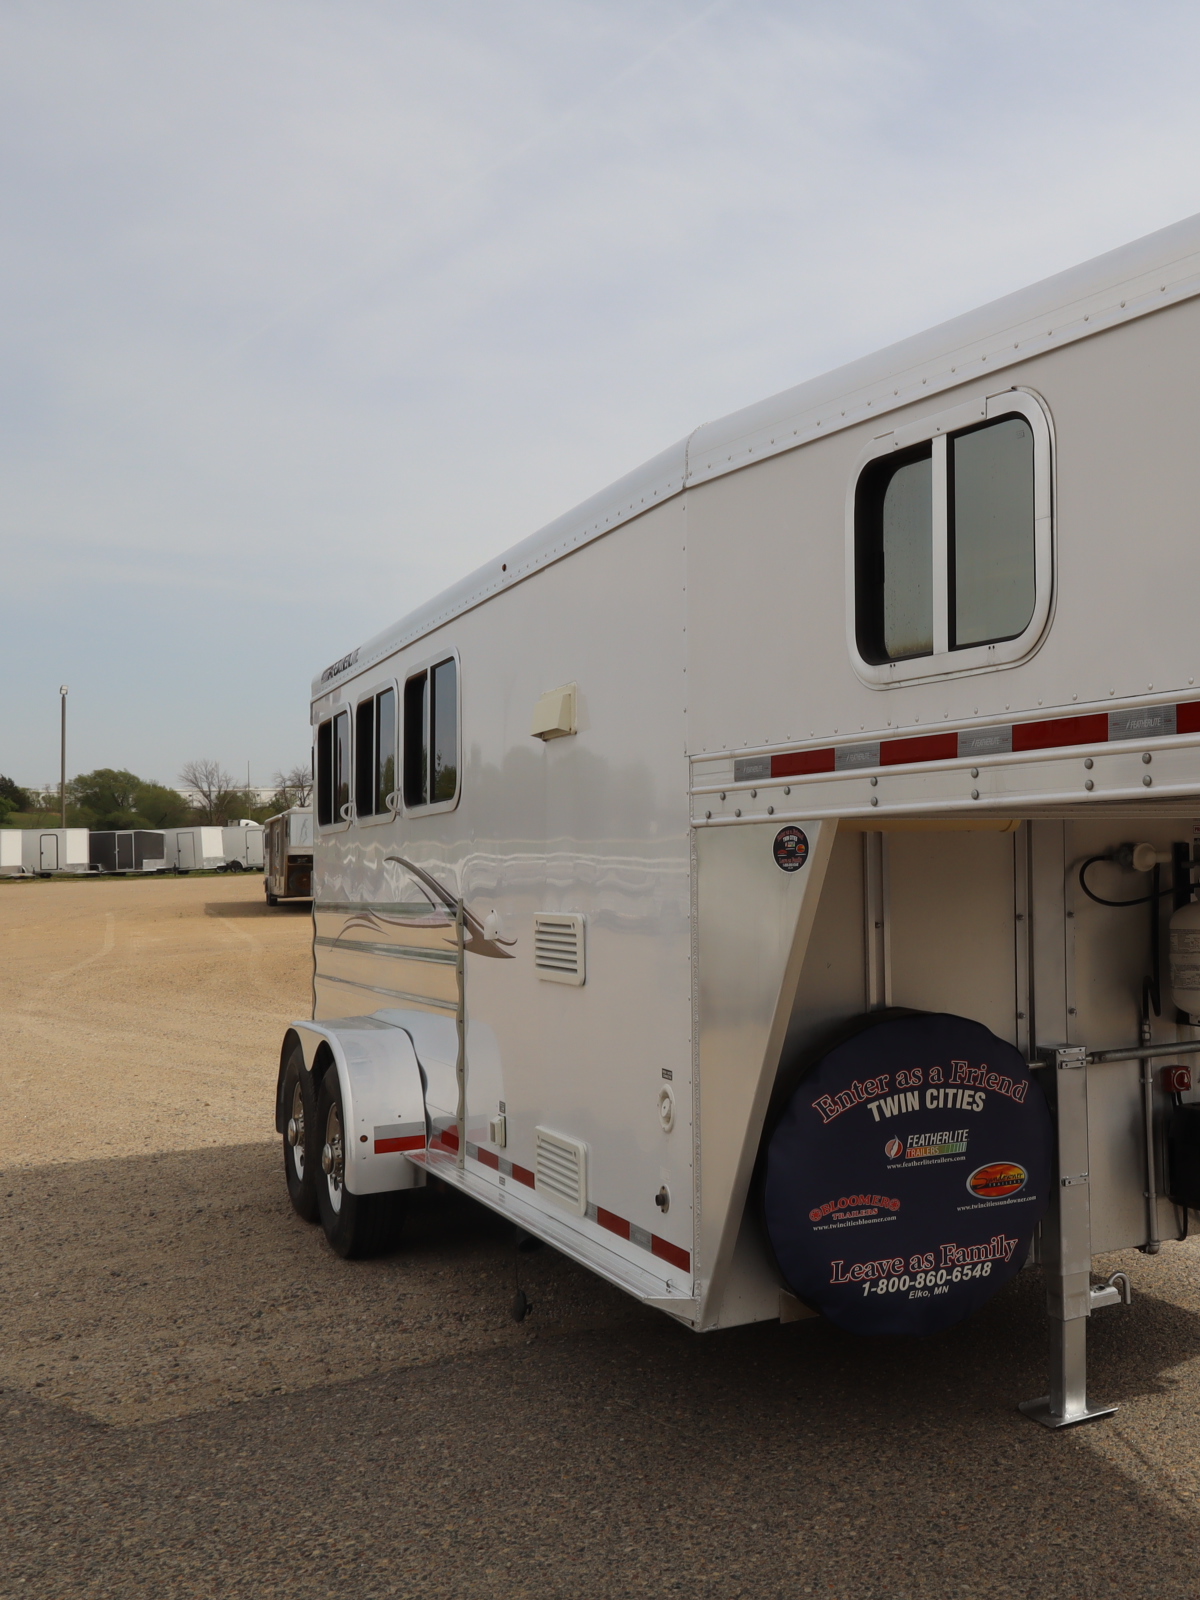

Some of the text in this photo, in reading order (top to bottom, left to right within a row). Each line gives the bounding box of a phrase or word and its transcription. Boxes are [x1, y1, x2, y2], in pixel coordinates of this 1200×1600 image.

[812, 1060, 1029, 1123] Enter as a Friend
[867, 1088, 986, 1122] TWIN CITIES
[907, 1129, 969, 1148] FEATHERLITE
[906, 1147, 939, 1158] TRAILERS
[887, 1156, 966, 1169] www.featherlitetrailers.com
[973, 1170, 1023, 1188] Sundowner
[820, 1194, 891, 1216] BLOOMER
[957, 1195, 1037, 1211] www.twincitiessundowner.com
[813, 1215, 897, 1231] www.twincitiesbloomer.com
[832, 1208, 879, 1221] TRAILERS
[829, 1234, 1019, 1284] Leave as Family
[862, 1261, 992, 1297] 1-800-860-6548
[908, 1285, 949, 1300] Elko, MN
